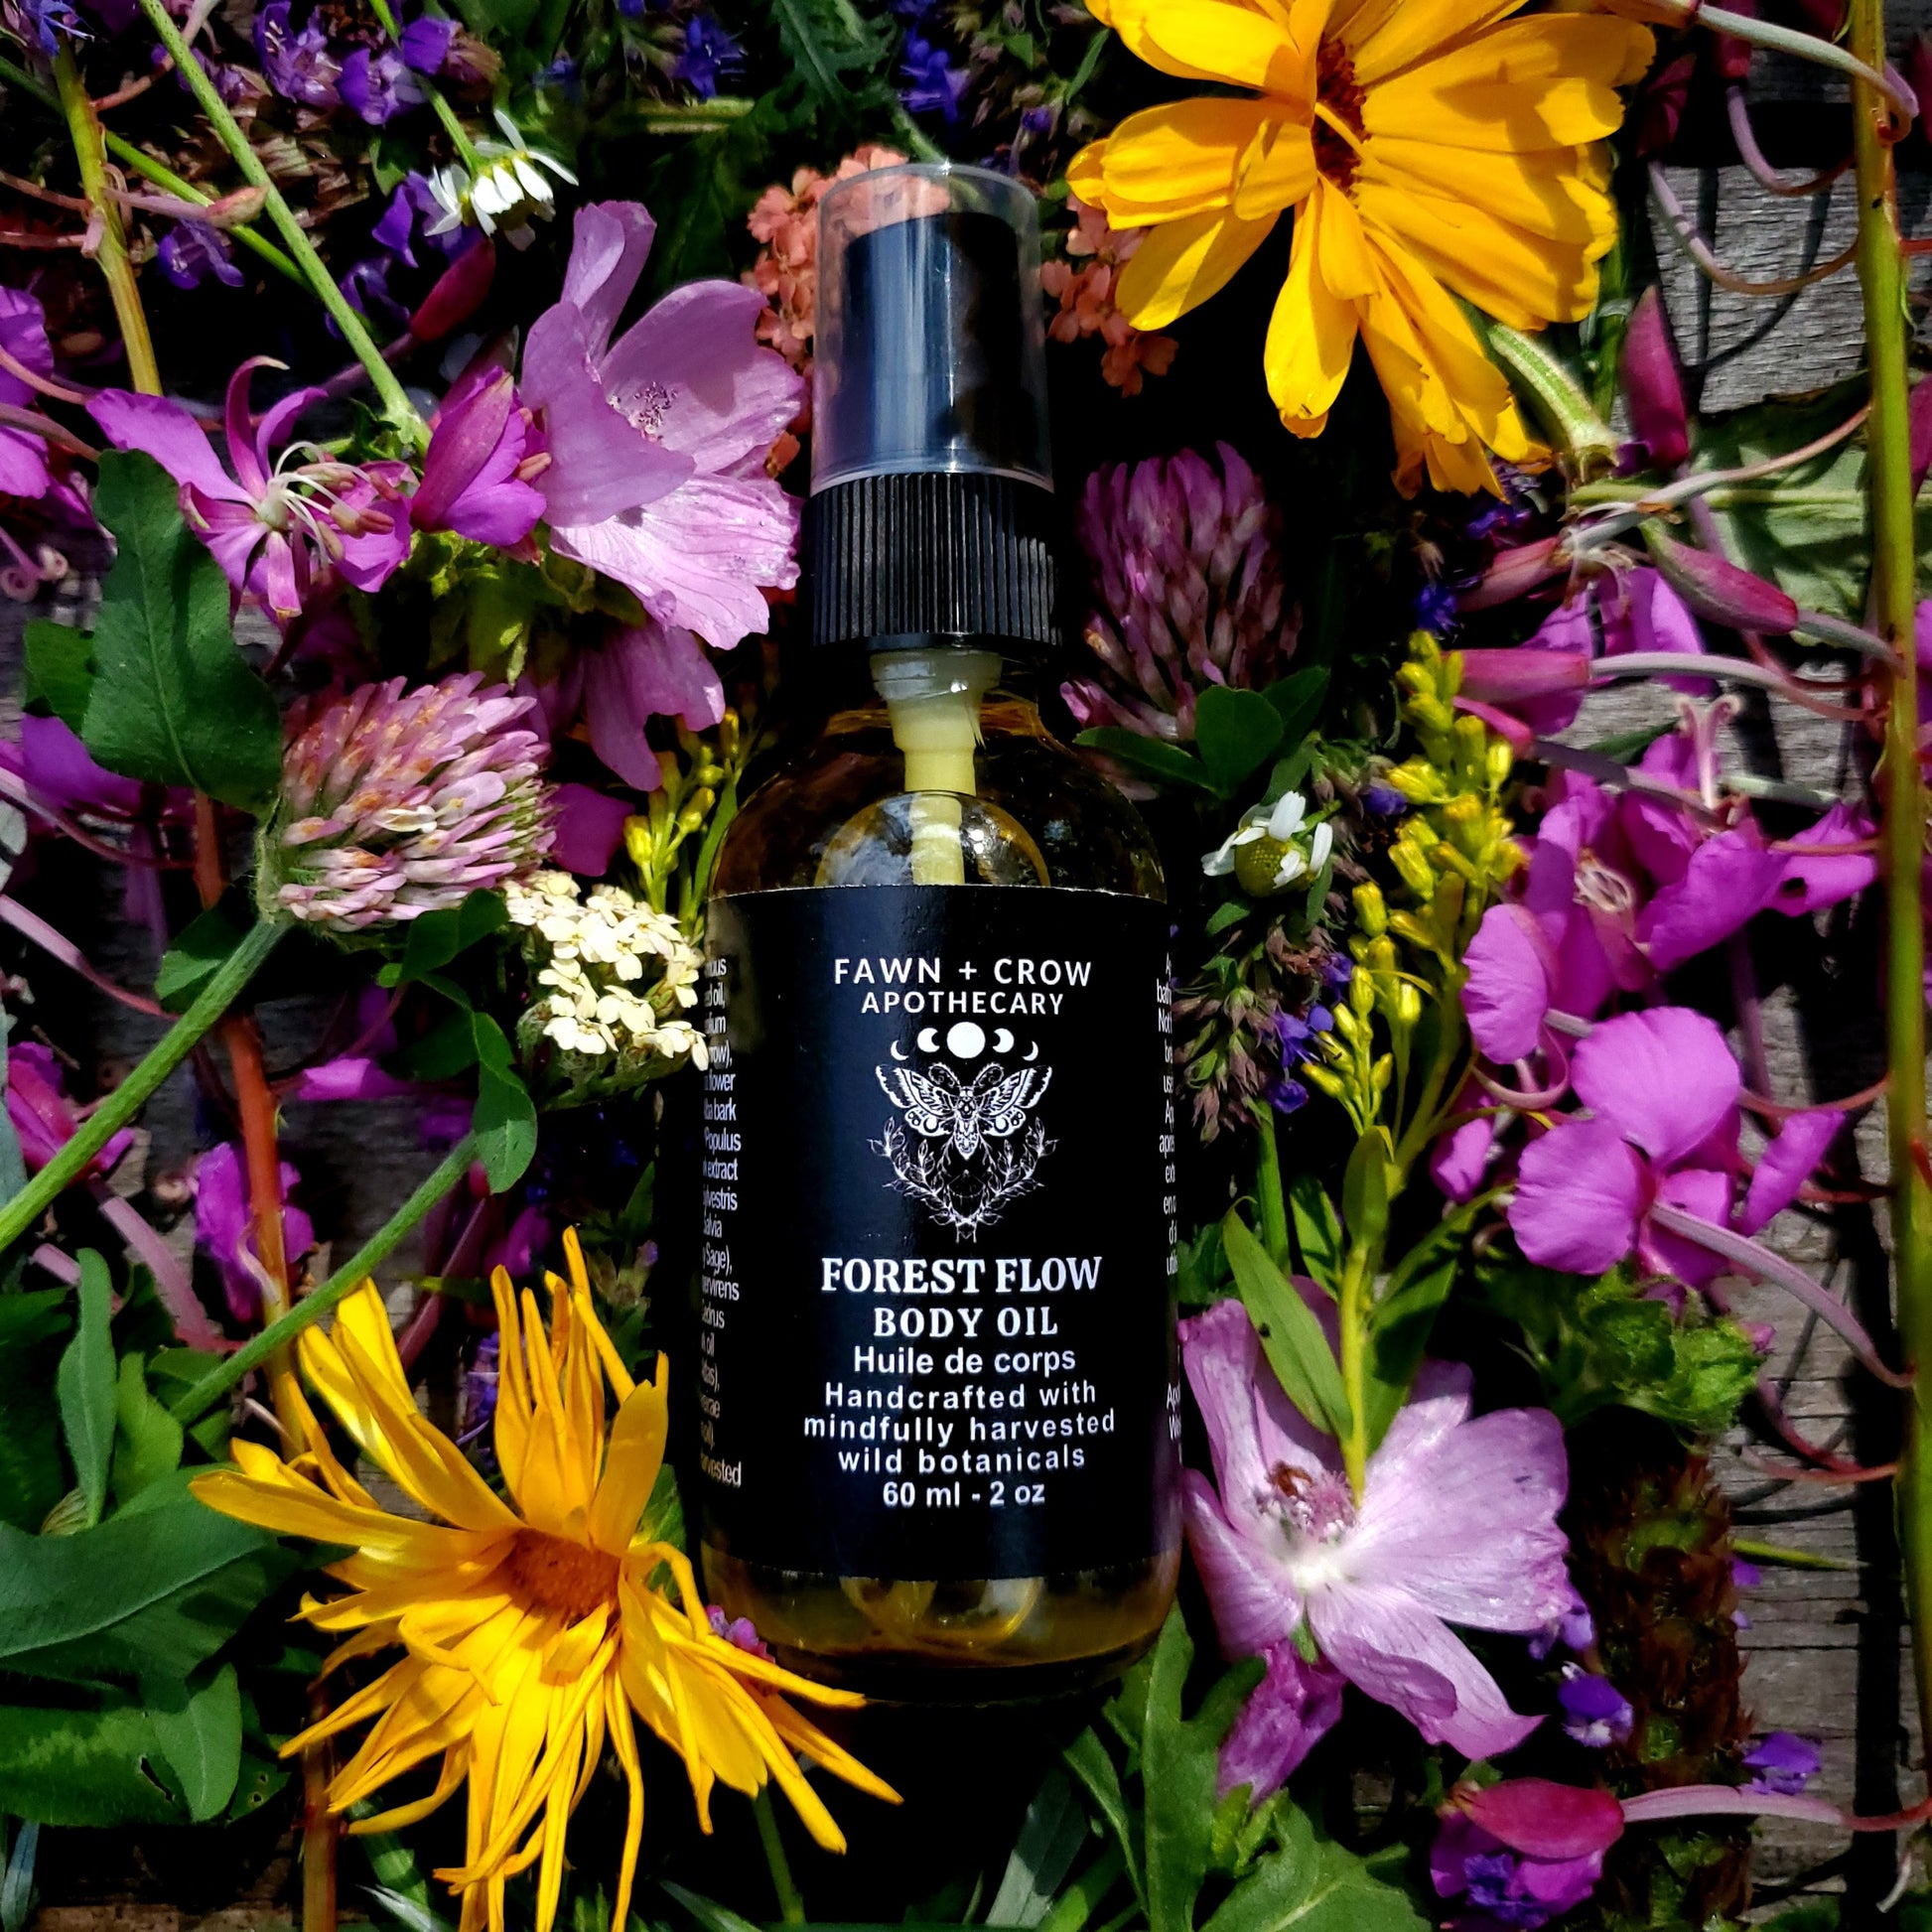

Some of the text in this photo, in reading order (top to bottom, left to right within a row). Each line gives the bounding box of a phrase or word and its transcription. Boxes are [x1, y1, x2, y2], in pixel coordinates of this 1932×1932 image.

[834, 957, 940, 985] FAWN
[994, 957, 1092, 987] CROW
[861, 991, 1063, 1016] APOTHECARY
[821, 1256, 1103, 1295] FOREST FLOW
[873, 1306, 1058, 1338] BODY OIL
[854, 1345, 1076, 1378] Huile de corps
[825, 1379, 1096, 1410] Handcrafted with
[804, 1407, 1115, 1448] mindfully harvested
[838, 1444, 1085, 1474] wild botanicals
[883, 1480, 916, 1507] 60
[925, 1480, 960, 1507] ml
[989, 1480, 1005, 1506] 2
[1015, 1482, 1045, 1504] oz
